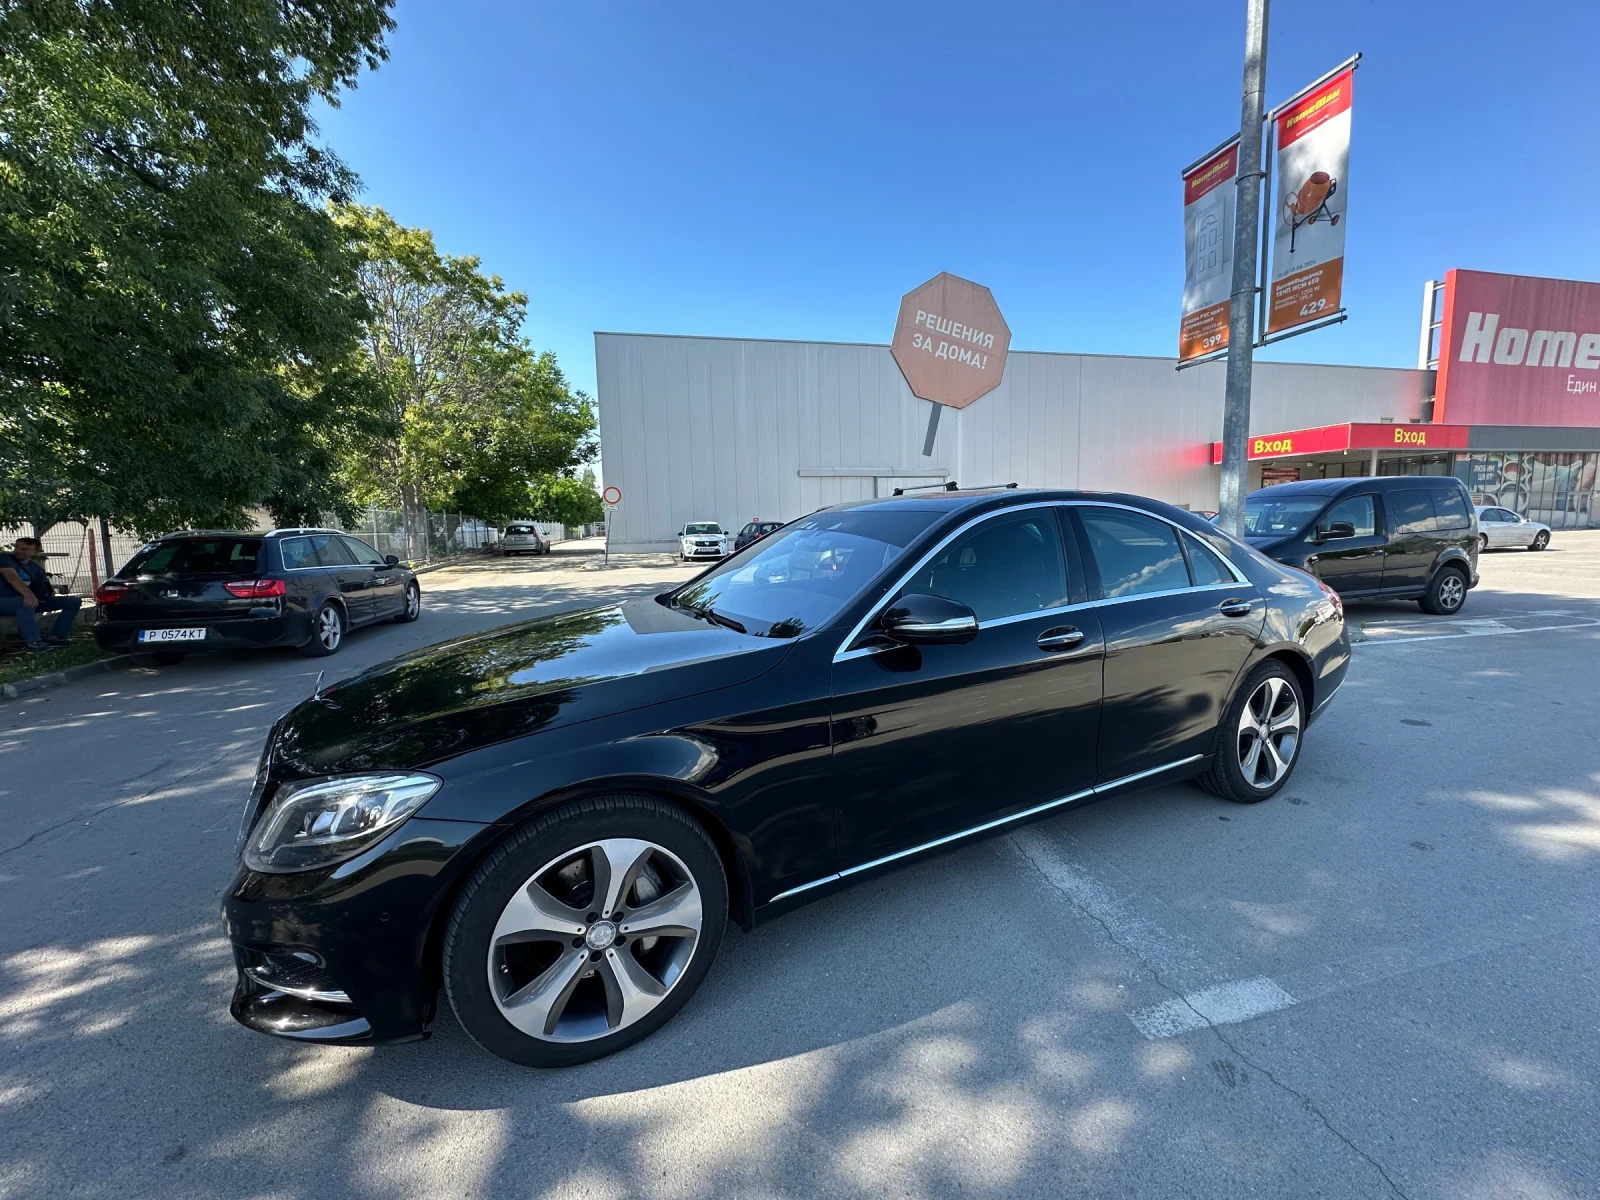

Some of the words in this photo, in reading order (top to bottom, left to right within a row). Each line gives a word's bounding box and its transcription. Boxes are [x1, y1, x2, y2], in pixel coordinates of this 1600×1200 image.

[1299, 298, 1326, 316] 429
[914, 310, 994, 349] РЕШЕНИЯ
[1203, 334, 1221, 348] 399
[1459, 311, 1600, 370] Home
[912, 333, 932, 353] ЗА
[935, 340, 988, 370] ДОМА!
[1567, 374, 1597, 395] Един
[1394, 428, 1427, 446] Вход
[1253, 438, 1293, 455] Вход
[149, 631, 157, 640] P
